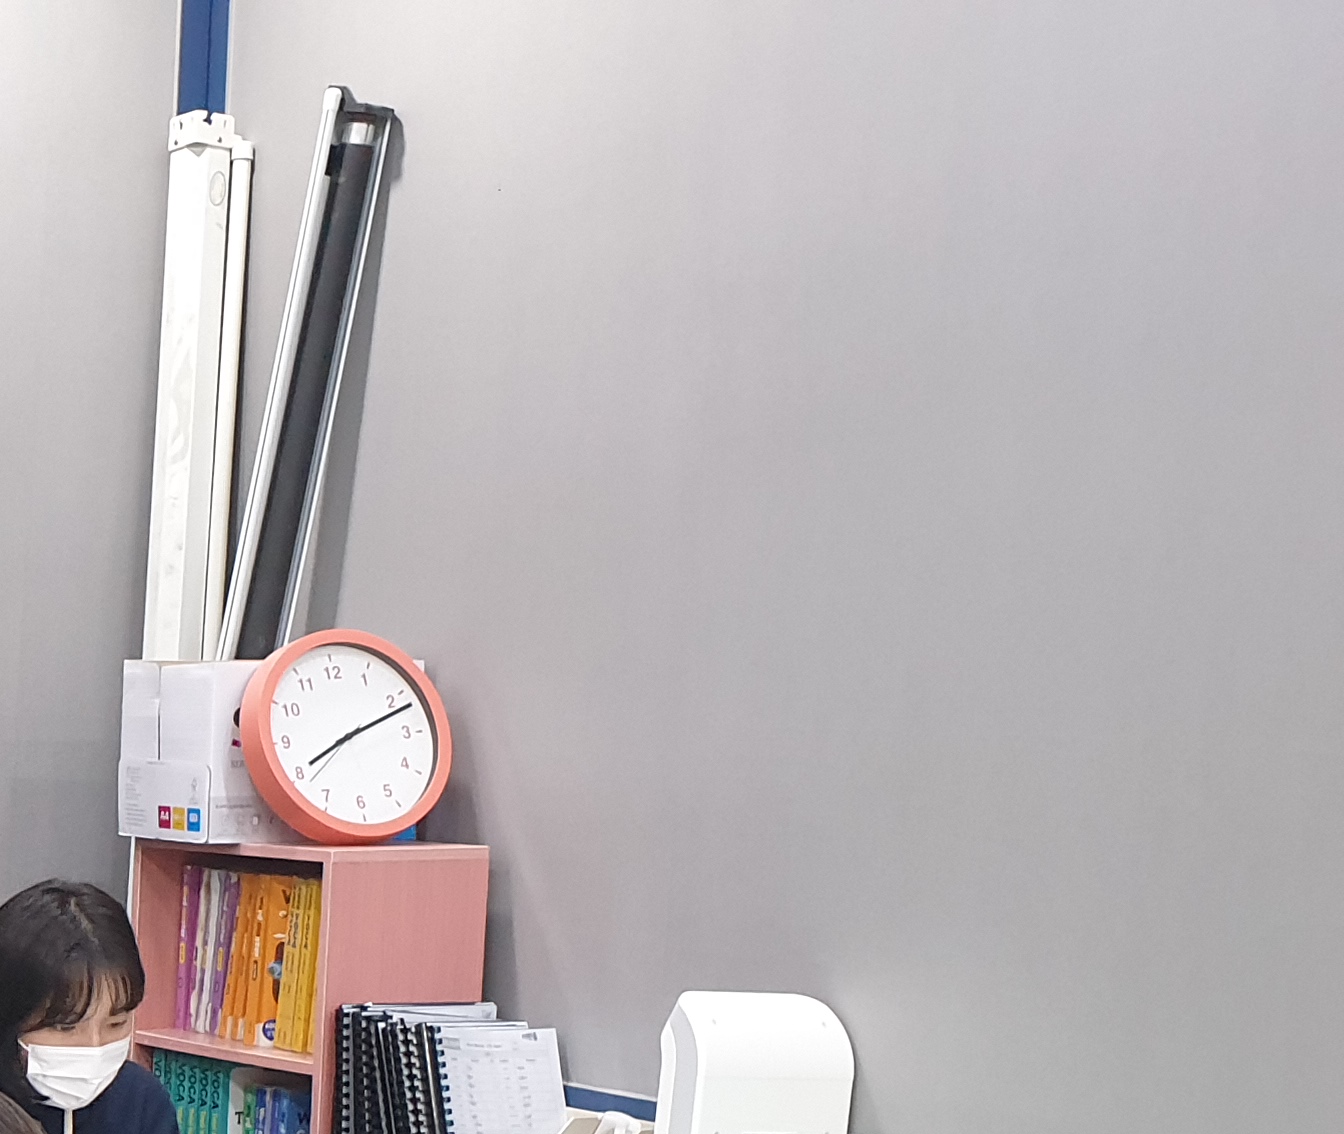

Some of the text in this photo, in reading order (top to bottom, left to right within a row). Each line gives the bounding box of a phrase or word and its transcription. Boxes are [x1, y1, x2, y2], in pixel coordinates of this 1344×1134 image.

[323, 666, 343, 680] 12
[361, 673, 368, 687] 1
[297, 677, 313, 691] 11
[386, 695, 395, 709] 2
[282, 702, 300, 717] 10
[401, 725, 411, 739] 3
[281, 735, 291, 749] 9
[400, 756, 409, 770] 4
[295, 766, 305, 780] 8
[321, 789, 330, 803] 7
[383, 784, 392, 798] 5
[356, 795, 366, 809] 6
[187, 1065, 198, 1105] VOCA
[199, 1068, 210, 1107] VOCA
[211, 1070, 221, 1110] VOCA
